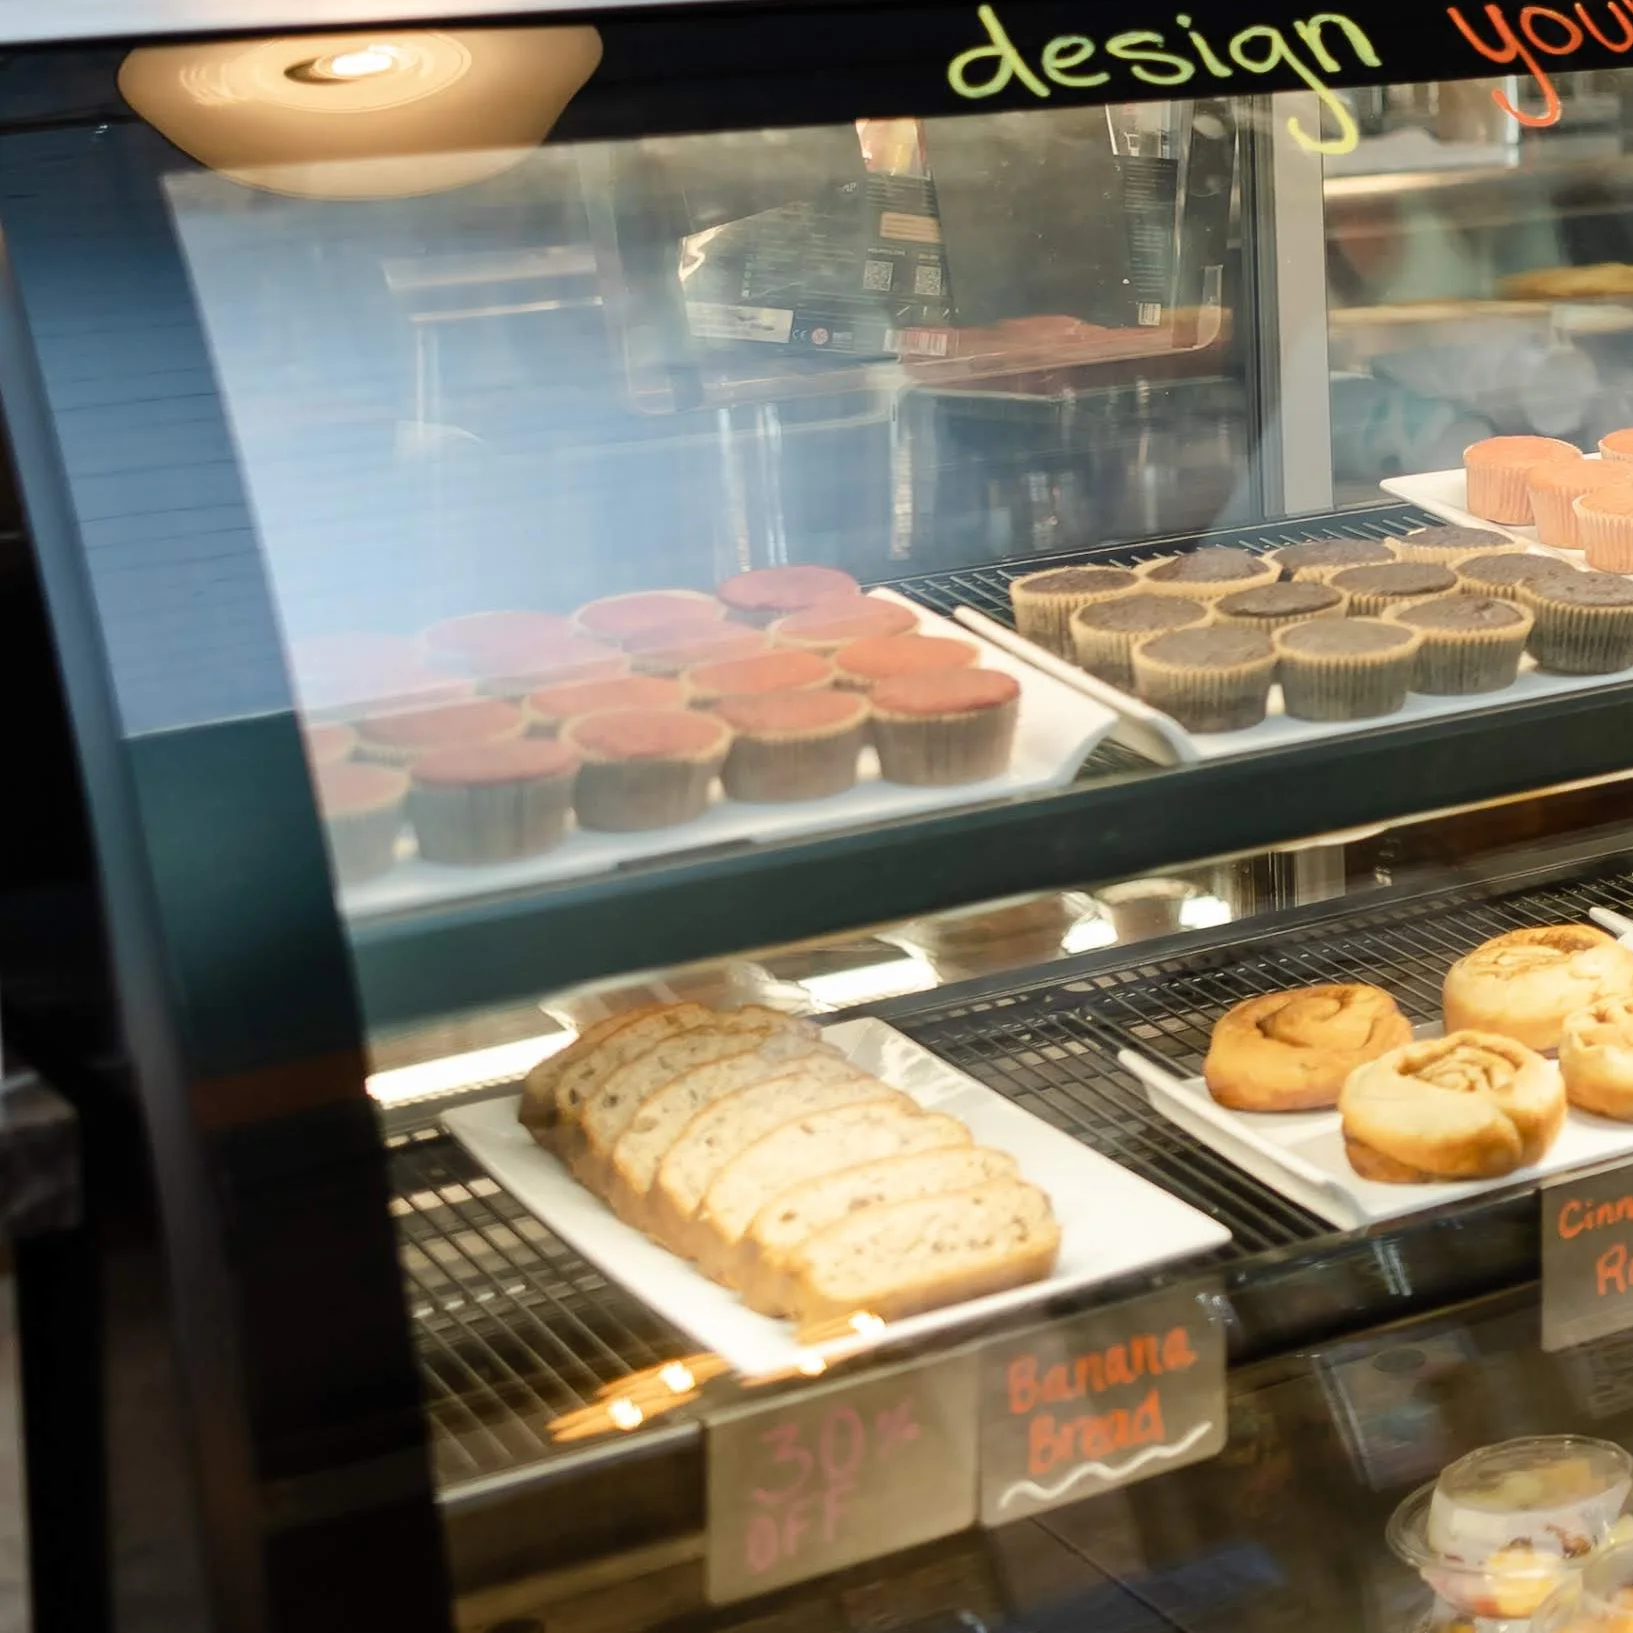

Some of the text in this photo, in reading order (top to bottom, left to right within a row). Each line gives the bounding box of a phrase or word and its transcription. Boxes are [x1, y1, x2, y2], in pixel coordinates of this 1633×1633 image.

[947, 4, 1383, 154] design
[1008, 1326, 1198, 1416] Banana
[755, 1395, 920, 1506] 30%
[1028, 1387, 1166, 1476] Bread
[745, 1477, 860, 1572] OFF
